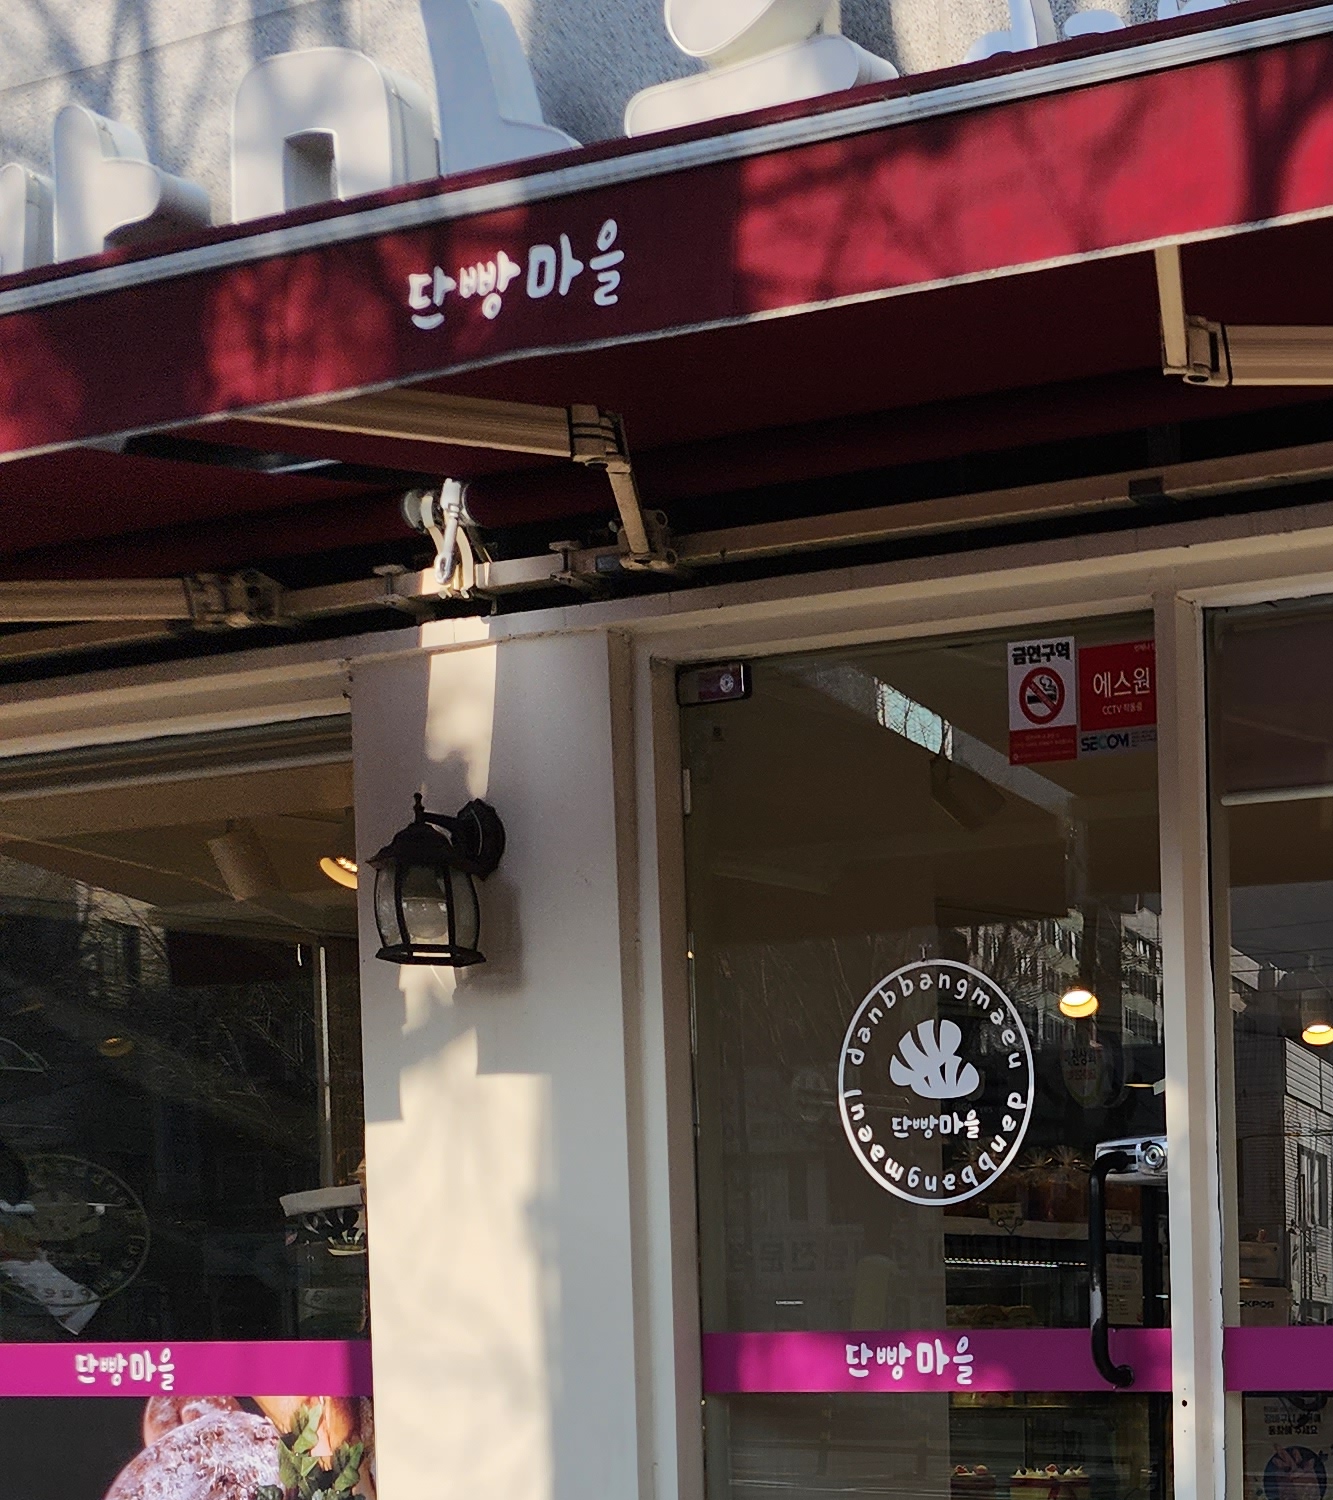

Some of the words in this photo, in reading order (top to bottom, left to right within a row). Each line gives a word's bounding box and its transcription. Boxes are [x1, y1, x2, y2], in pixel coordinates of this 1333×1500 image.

[408, 218, 625, 330] 단빵마을
[1011, 641, 1071, 666] 금연구역
[1093, 667, 1151, 698] 에스원
[1102, 704, 1121, 715] CCTV
[1081, 732, 1129, 752] SECOM
[891, 1109, 980, 1139] 단빵마을
[74, 1347, 176, 1391] 단빵마을
[845, 1335, 974, 1385] 단빵마을
